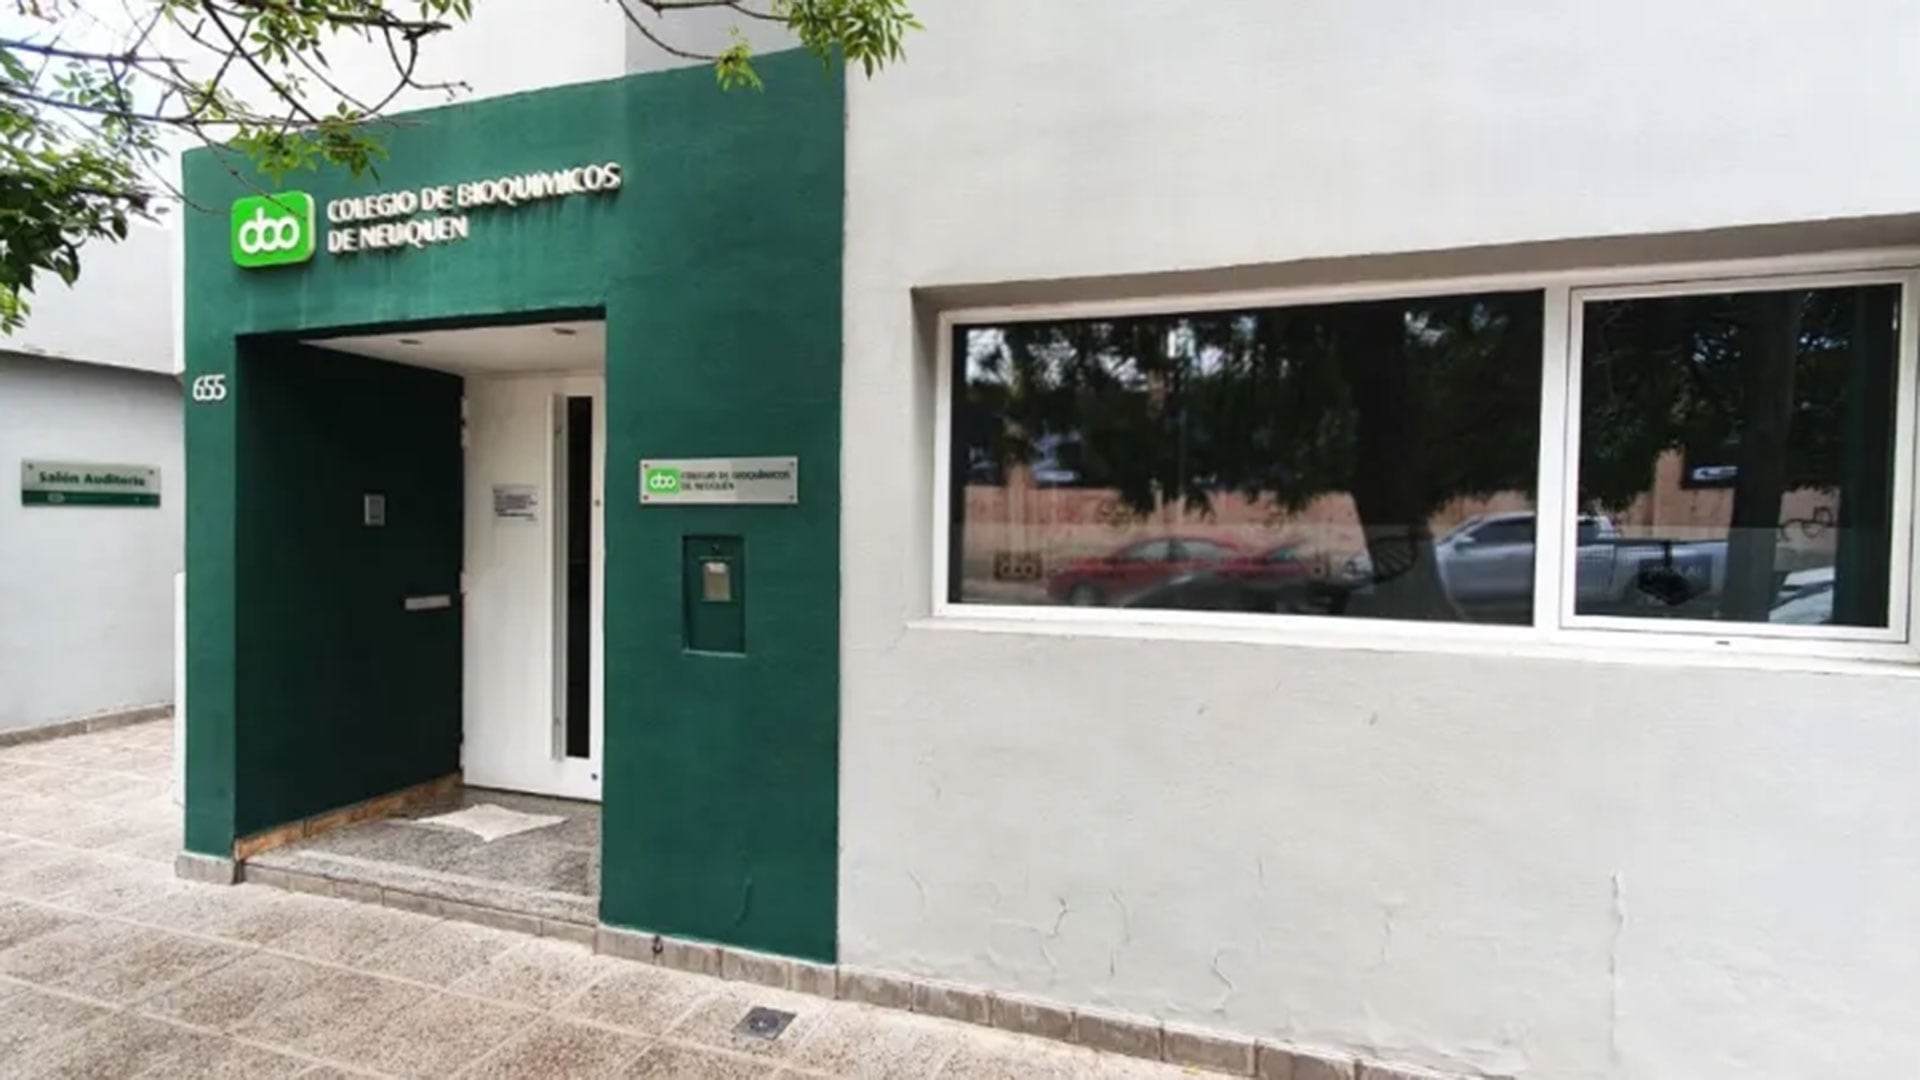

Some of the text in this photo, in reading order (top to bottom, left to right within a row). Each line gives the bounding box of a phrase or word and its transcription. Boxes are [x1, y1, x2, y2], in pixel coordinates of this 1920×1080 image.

[327, 190, 418, 222] COLEGIO
[421, 186, 454, 211] DE
[327, 228, 358, 253] DE
[193, 374, 227, 401] 655
